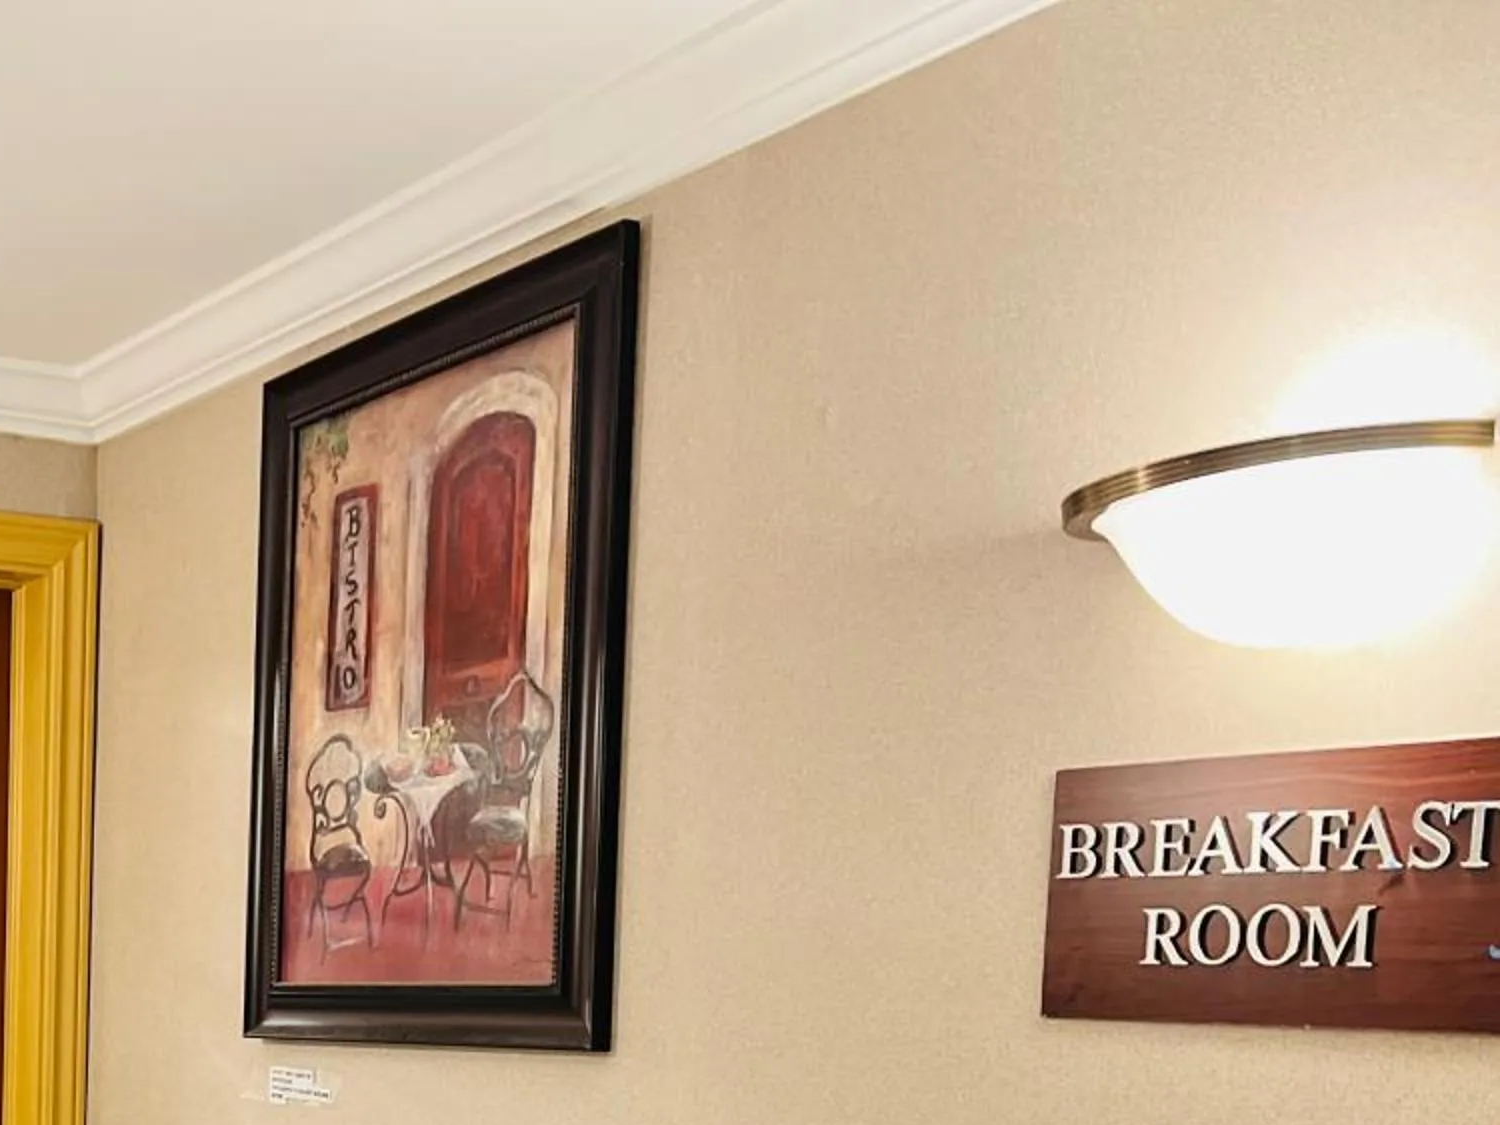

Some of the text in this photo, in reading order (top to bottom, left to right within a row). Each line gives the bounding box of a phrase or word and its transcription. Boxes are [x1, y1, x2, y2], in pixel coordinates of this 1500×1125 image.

[342, 505, 362, 690] BISTRO
[1056, 800, 1500, 880] BREAKFAST
[1139, 903, 1377, 968] ROOM
